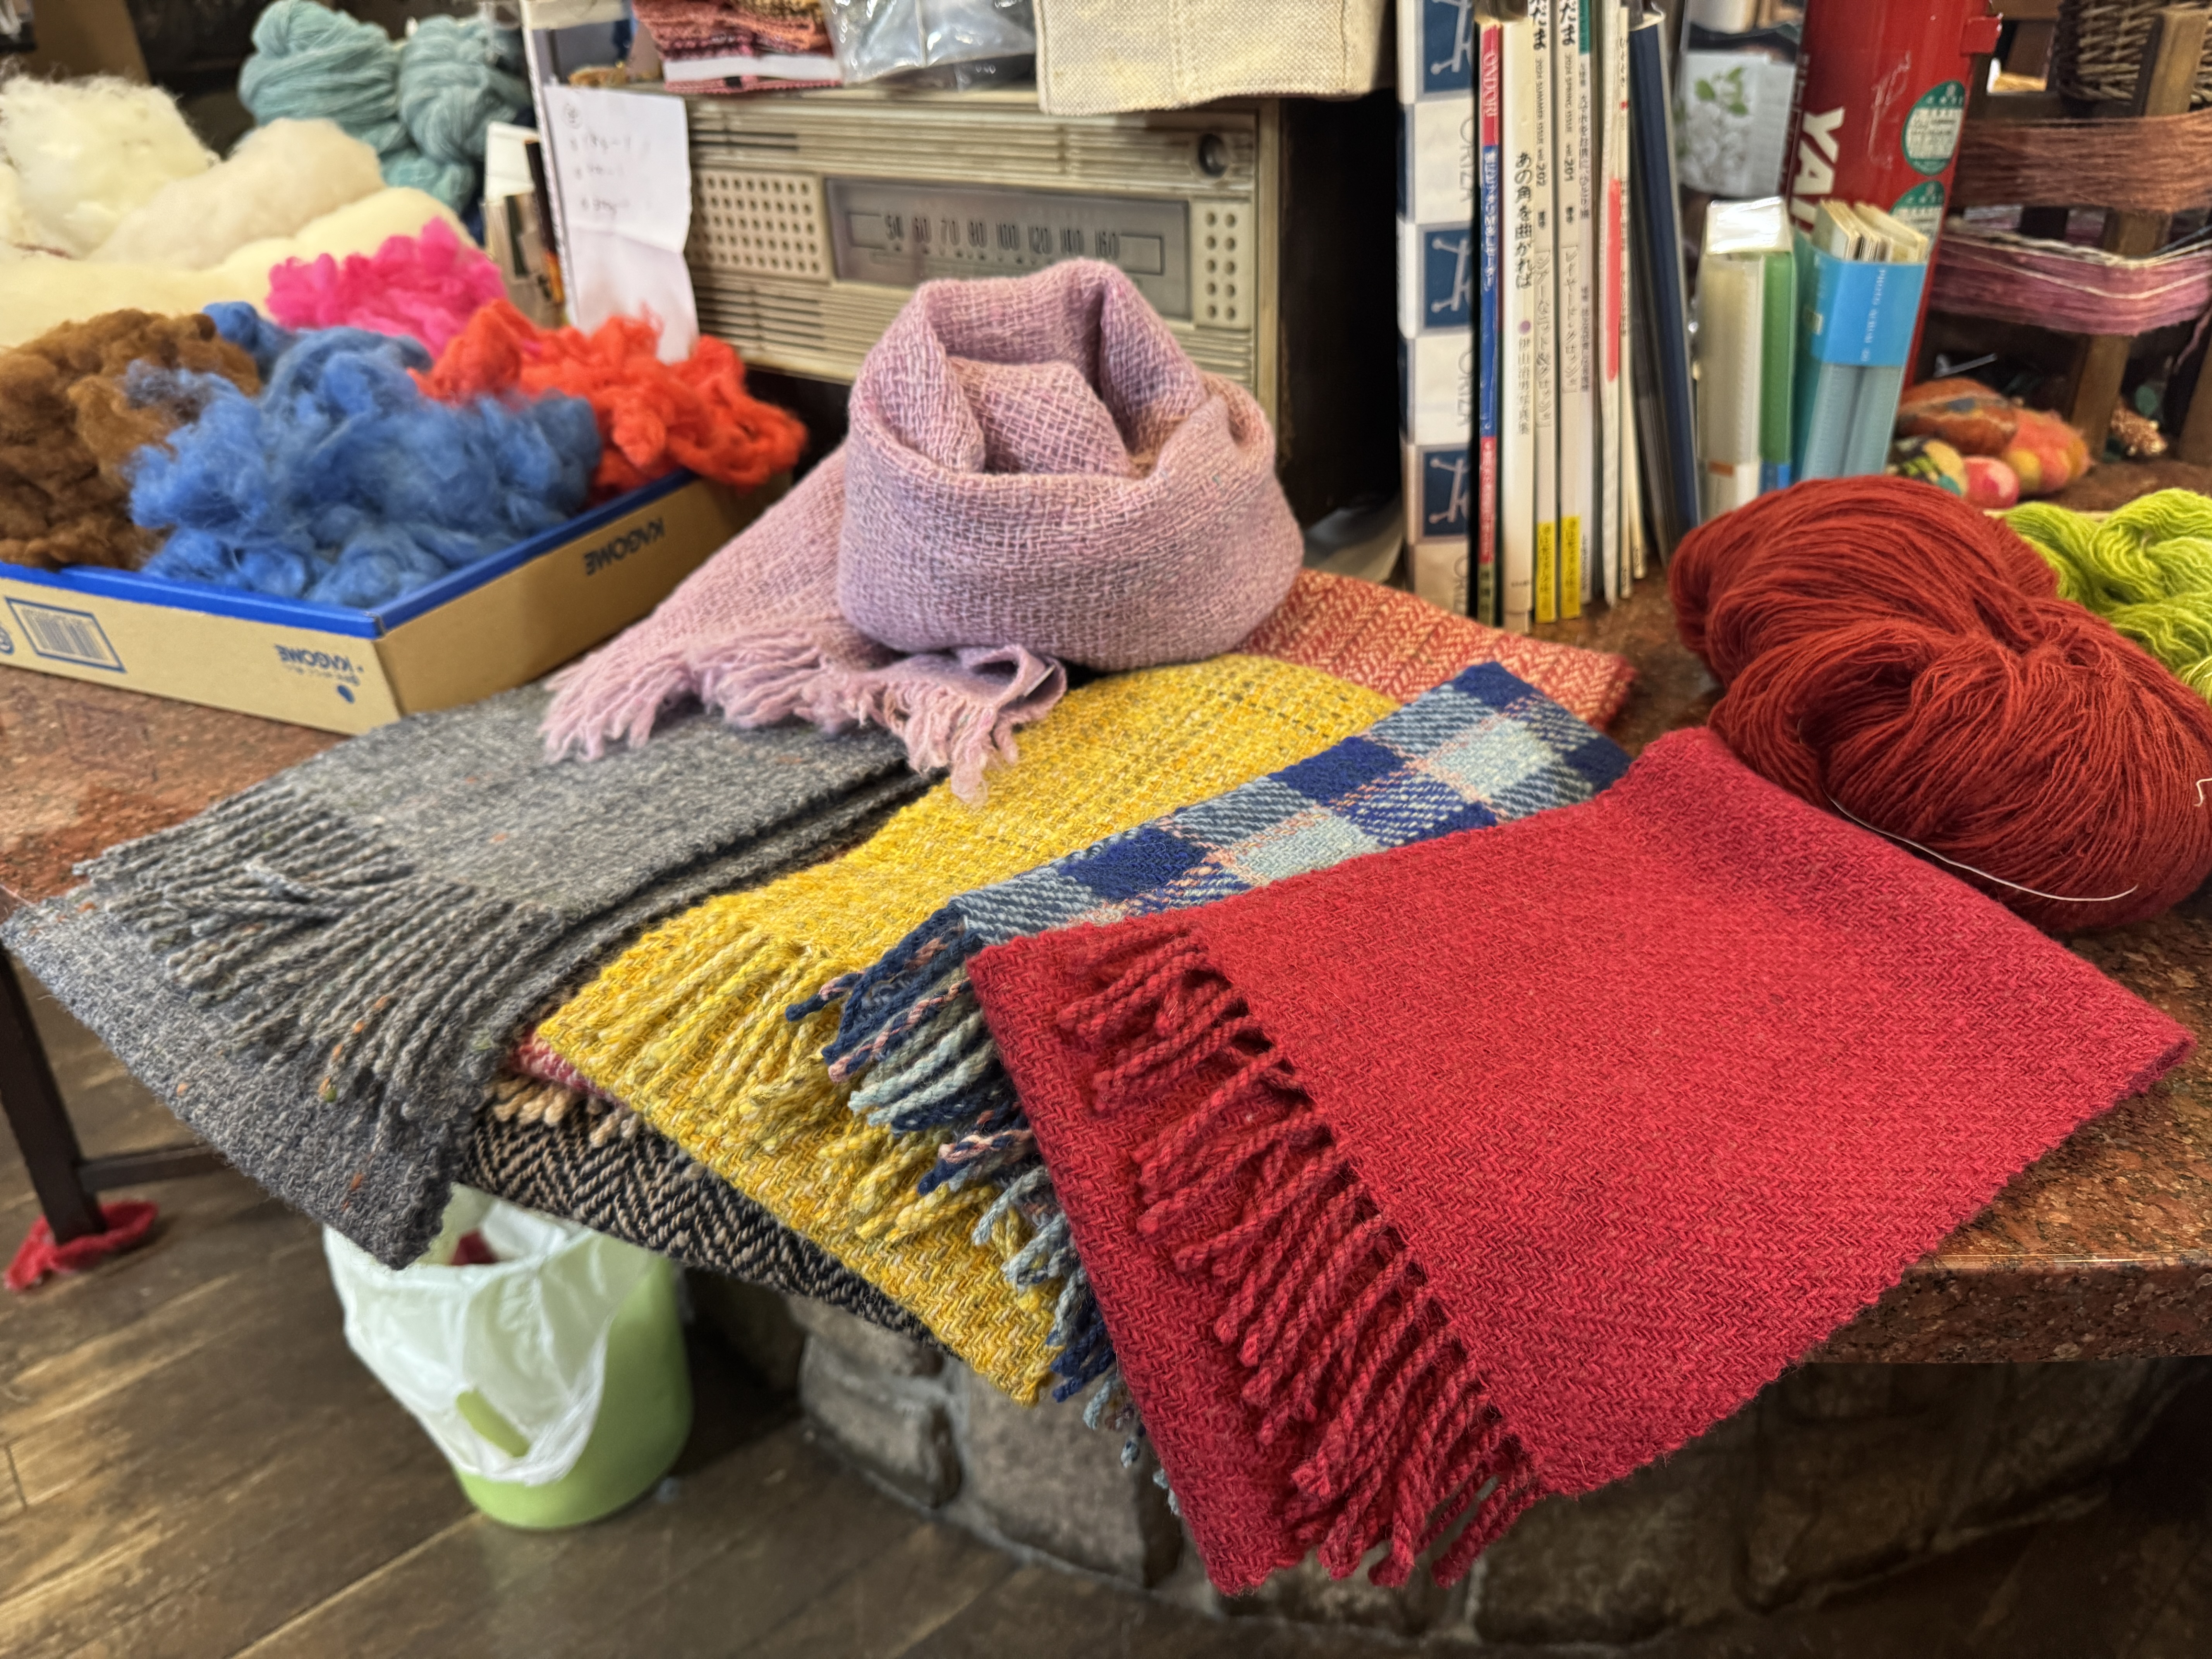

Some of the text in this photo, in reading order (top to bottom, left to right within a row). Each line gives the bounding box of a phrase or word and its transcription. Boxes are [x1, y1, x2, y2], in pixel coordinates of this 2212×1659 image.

[1535, 81, 1544, 119] SUMMER
[941, 218, 960, 246] 70
[996, 223, 1020, 251] 100
[1028, 225, 1053, 254] 120
[1095, 229, 1120, 261] 160
[1514, 152, 1534, 290] あの角を曲がれば
[583, 518, 664, 576] KAGOME
[274, 644, 353, 673] KAGOME
